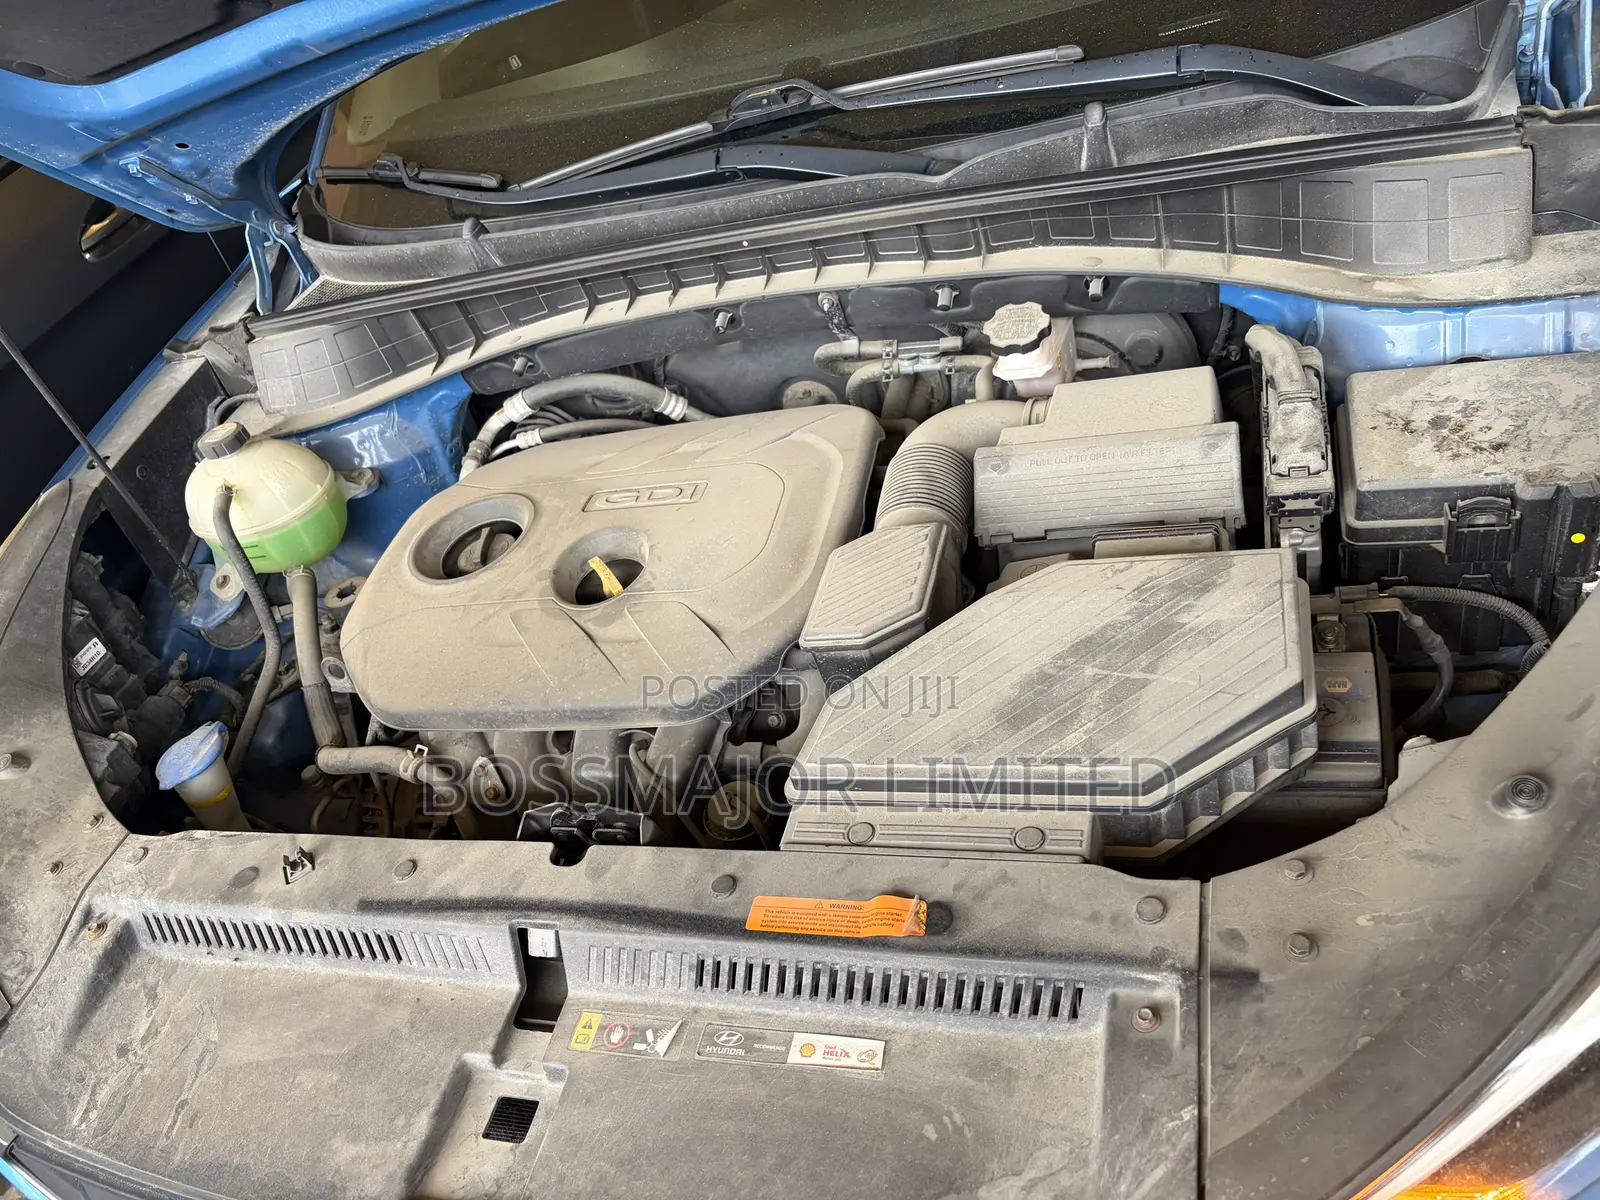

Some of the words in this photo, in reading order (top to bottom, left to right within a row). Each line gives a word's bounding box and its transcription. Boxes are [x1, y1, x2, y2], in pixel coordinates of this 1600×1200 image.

[1029, 458, 1053, 467] PULL
[1054, 455, 1073, 465] OUT
[1076, 454, 1087, 462] TO
[1089, 451, 1115, 461] OPEN
[595, 484, 699, 508] GDI
[830, 903, 864, 911] WARNING:
[706, 1046, 746, 1056] HYUNDAI
[823, 1048, 852, 1059] HELIX
